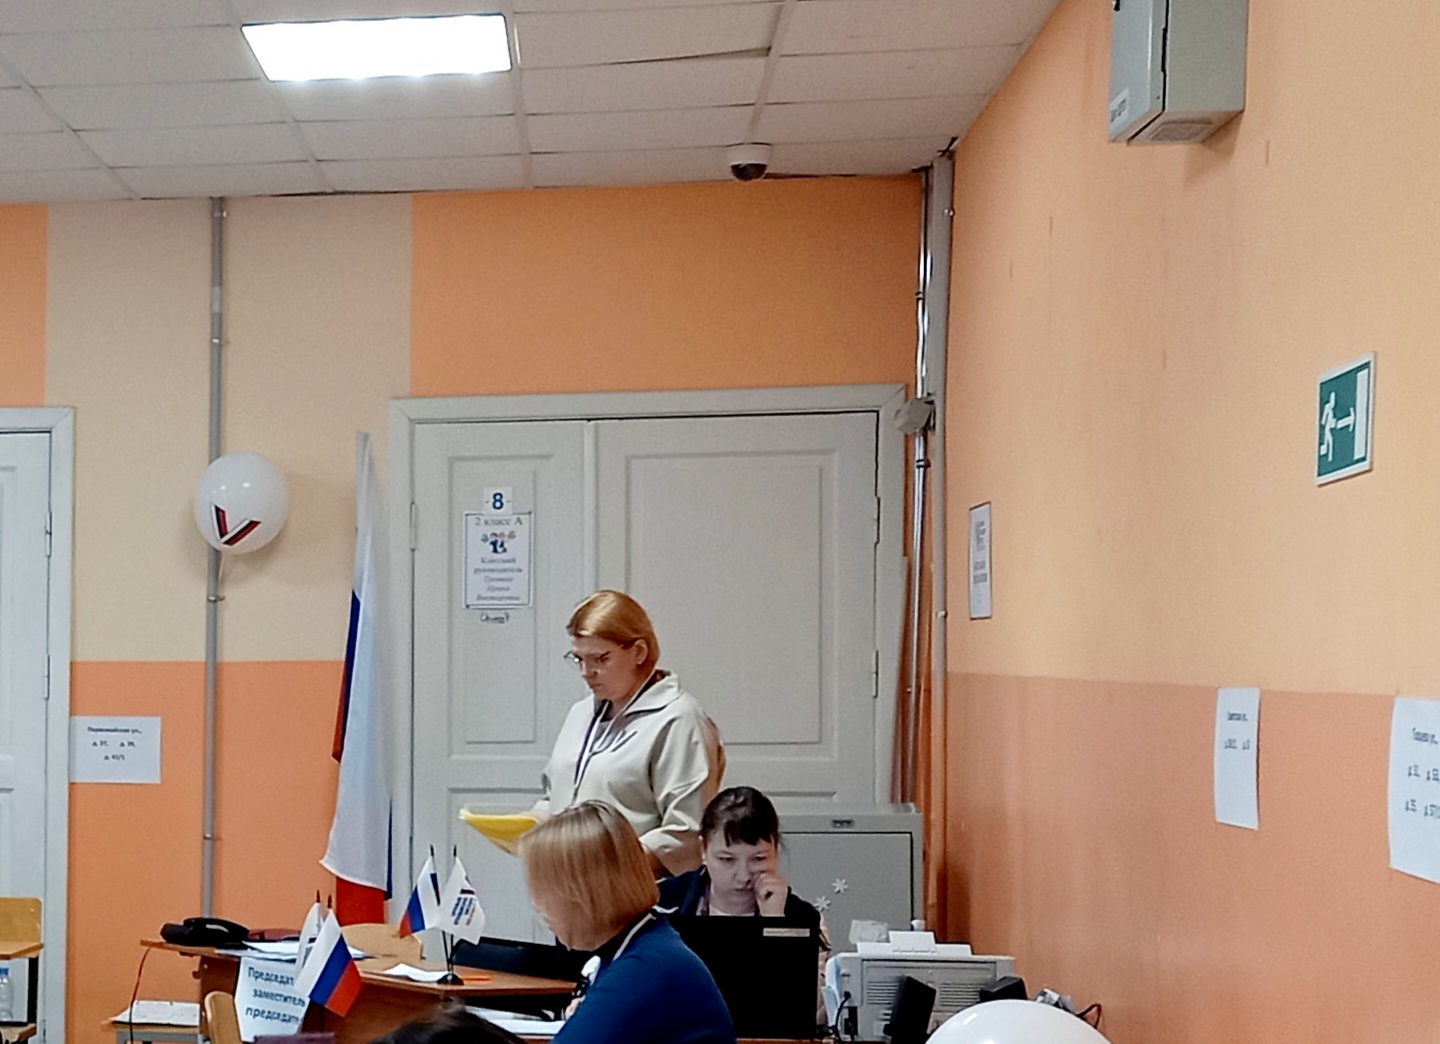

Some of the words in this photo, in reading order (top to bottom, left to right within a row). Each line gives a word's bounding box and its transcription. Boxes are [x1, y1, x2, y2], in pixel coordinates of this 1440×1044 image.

[492, 492, 504, 510] 8
[484, 518, 511, 526] класс
[514, 517, 523, 525] А
[248, 966, 294, 986] Председат
[253, 988, 306, 1008] заместитель
